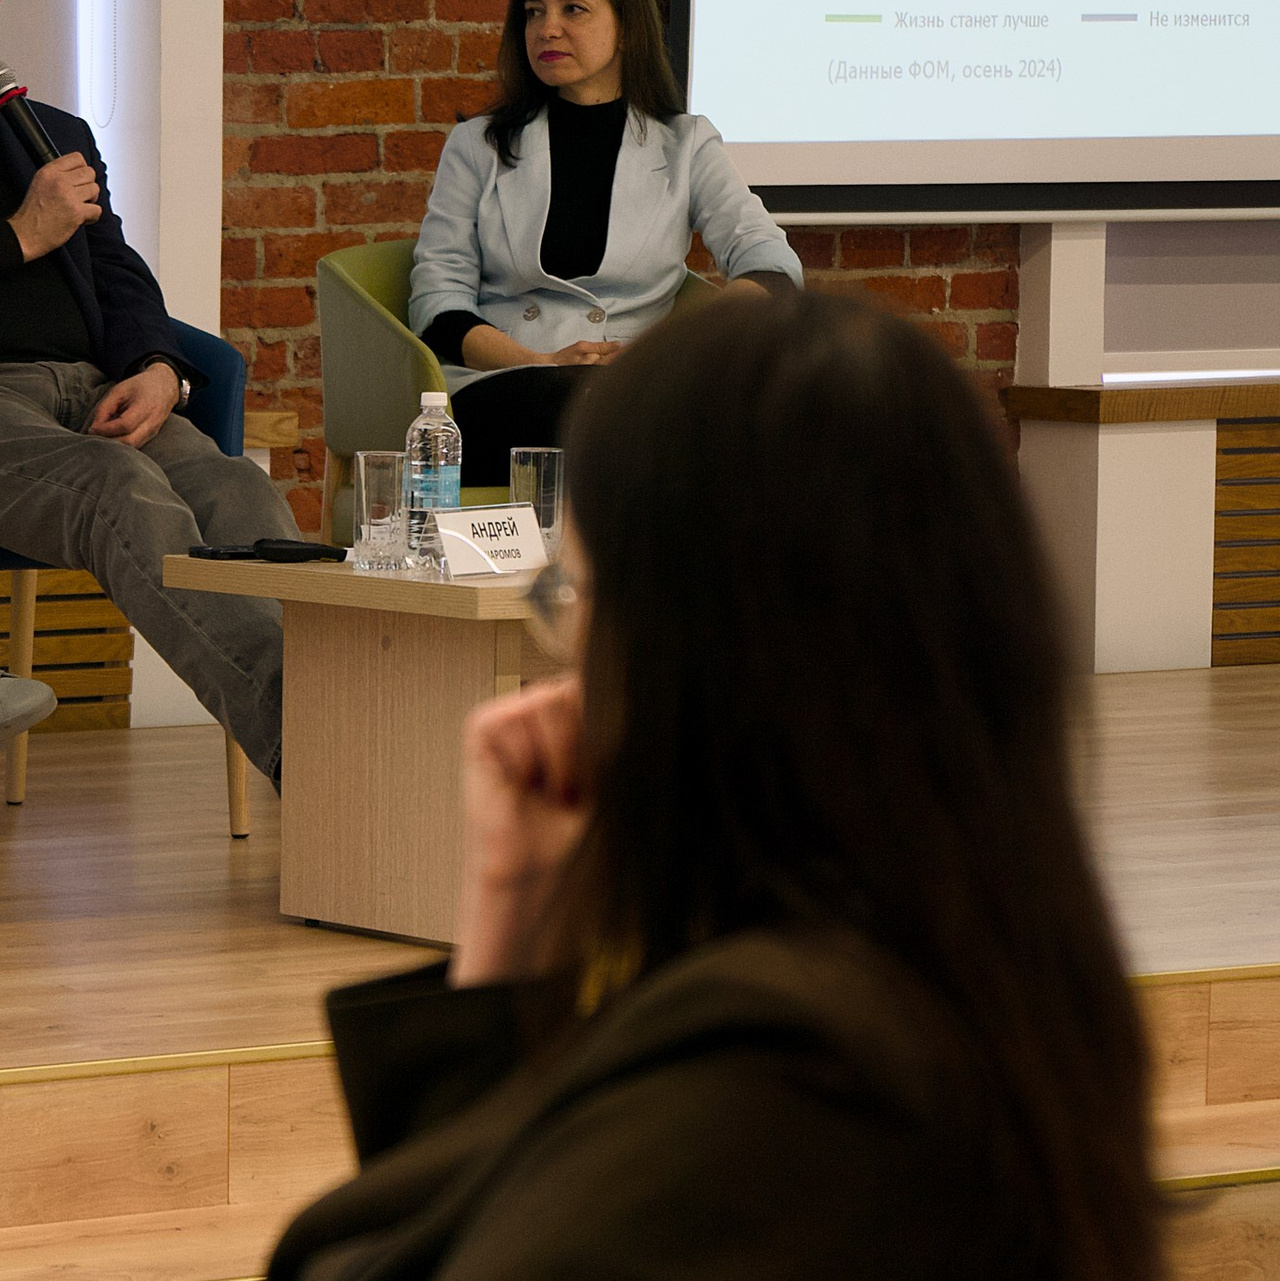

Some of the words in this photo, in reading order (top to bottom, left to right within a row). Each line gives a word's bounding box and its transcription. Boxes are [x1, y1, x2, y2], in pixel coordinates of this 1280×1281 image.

[894, 11, 945, 29] Жизнь
[950, 13, 998, 29] станет
[1002, 13, 1049, 31] лучше
[1149, 11, 1169, 28] Не
[1173, 13, 1251, 28] изменится
[827, 59, 903, 85] (Данные
[908, 59, 956, 83] ФОМ,
[962, 62, 1014, 80] осень
[1018, 58, 1063, 83] 2024)
[471, 516, 519, 541] АНДРЕЙ
